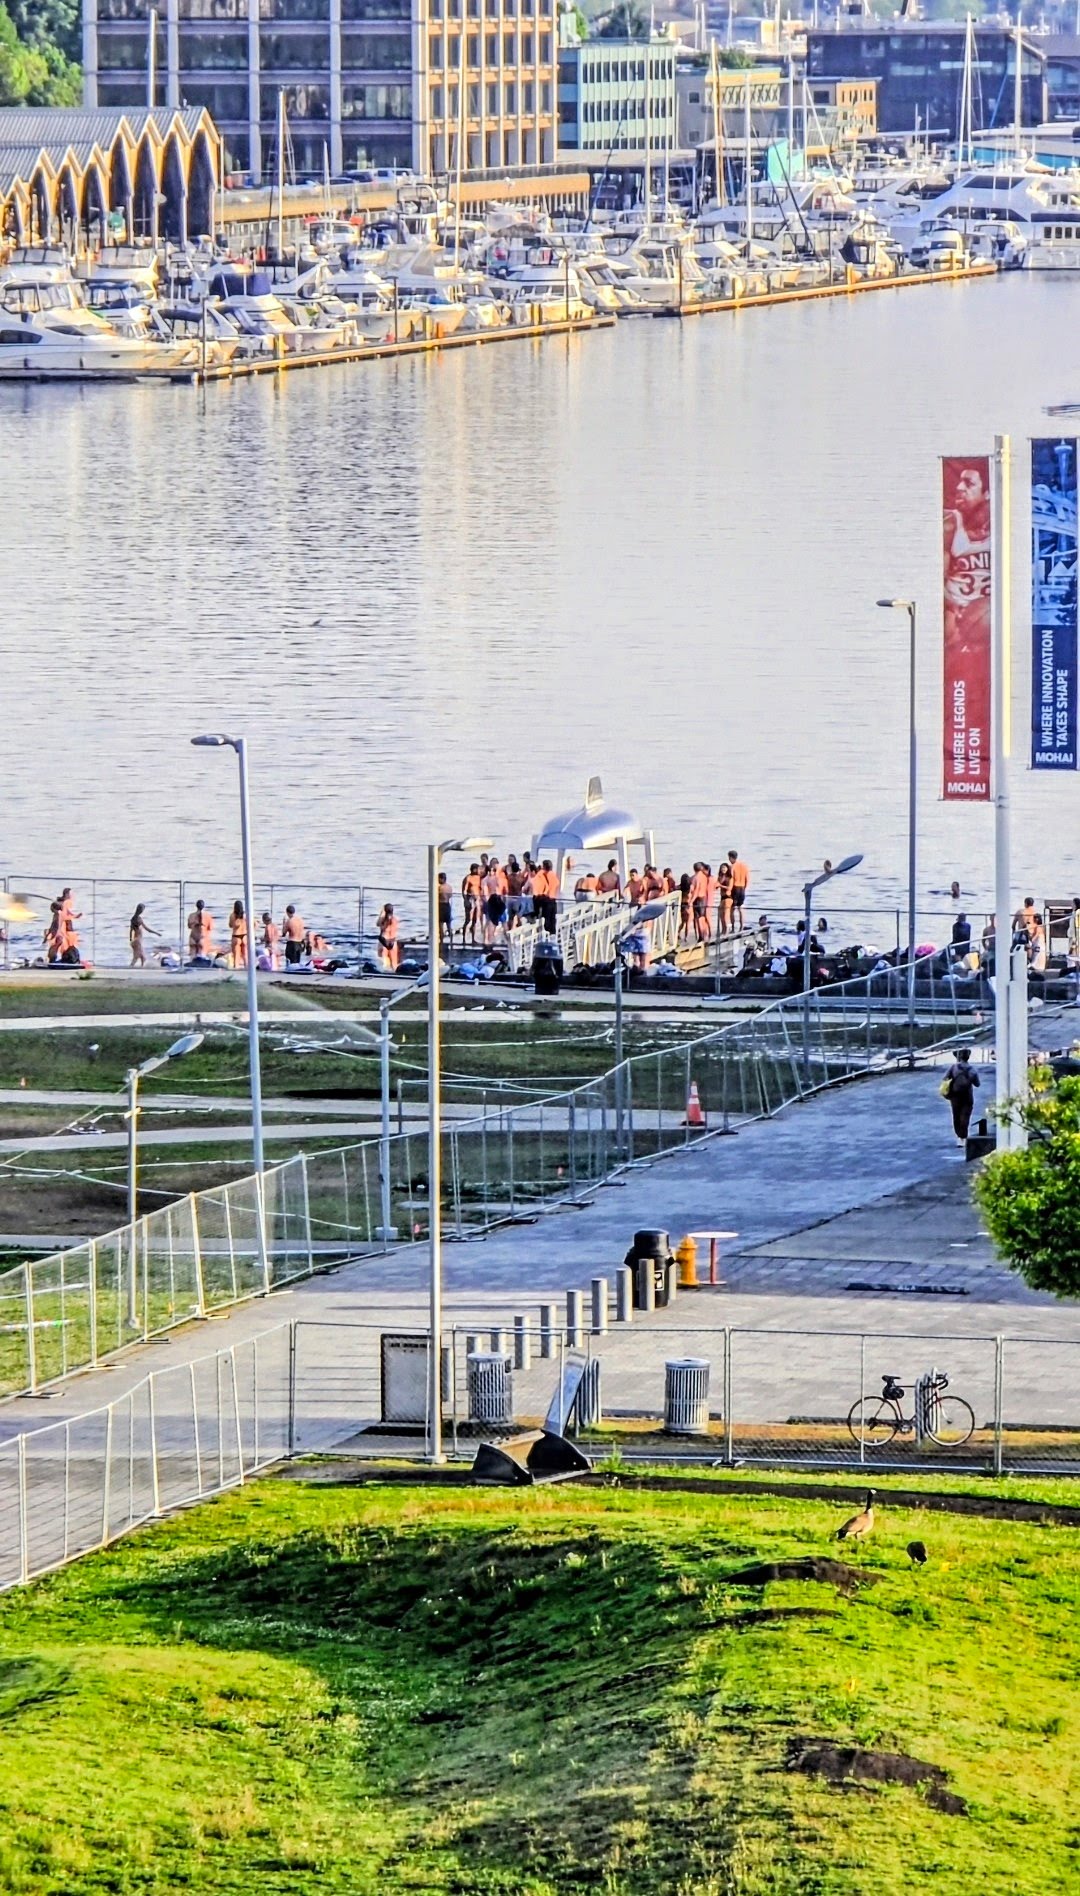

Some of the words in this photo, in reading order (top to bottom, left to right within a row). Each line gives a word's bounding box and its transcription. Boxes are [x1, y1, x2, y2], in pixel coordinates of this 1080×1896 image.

[1041, 630, 1053, 702] INNOVATION
[953, 680, 965, 728] LEGNDS
[1057, 669, 1068, 709] SHAPE
[969, 728, 980, 748] ON
[1041, 705, 1053, 747] WHERE
[1057, 711, 1068, 748] TAKES
[953, 732, 965, 775] WHERE
[969, 749, 980, 775] LIVE
[1035, 752, 1073, 763] MOHAI
[947, 782, 986, 793] MOHAI
